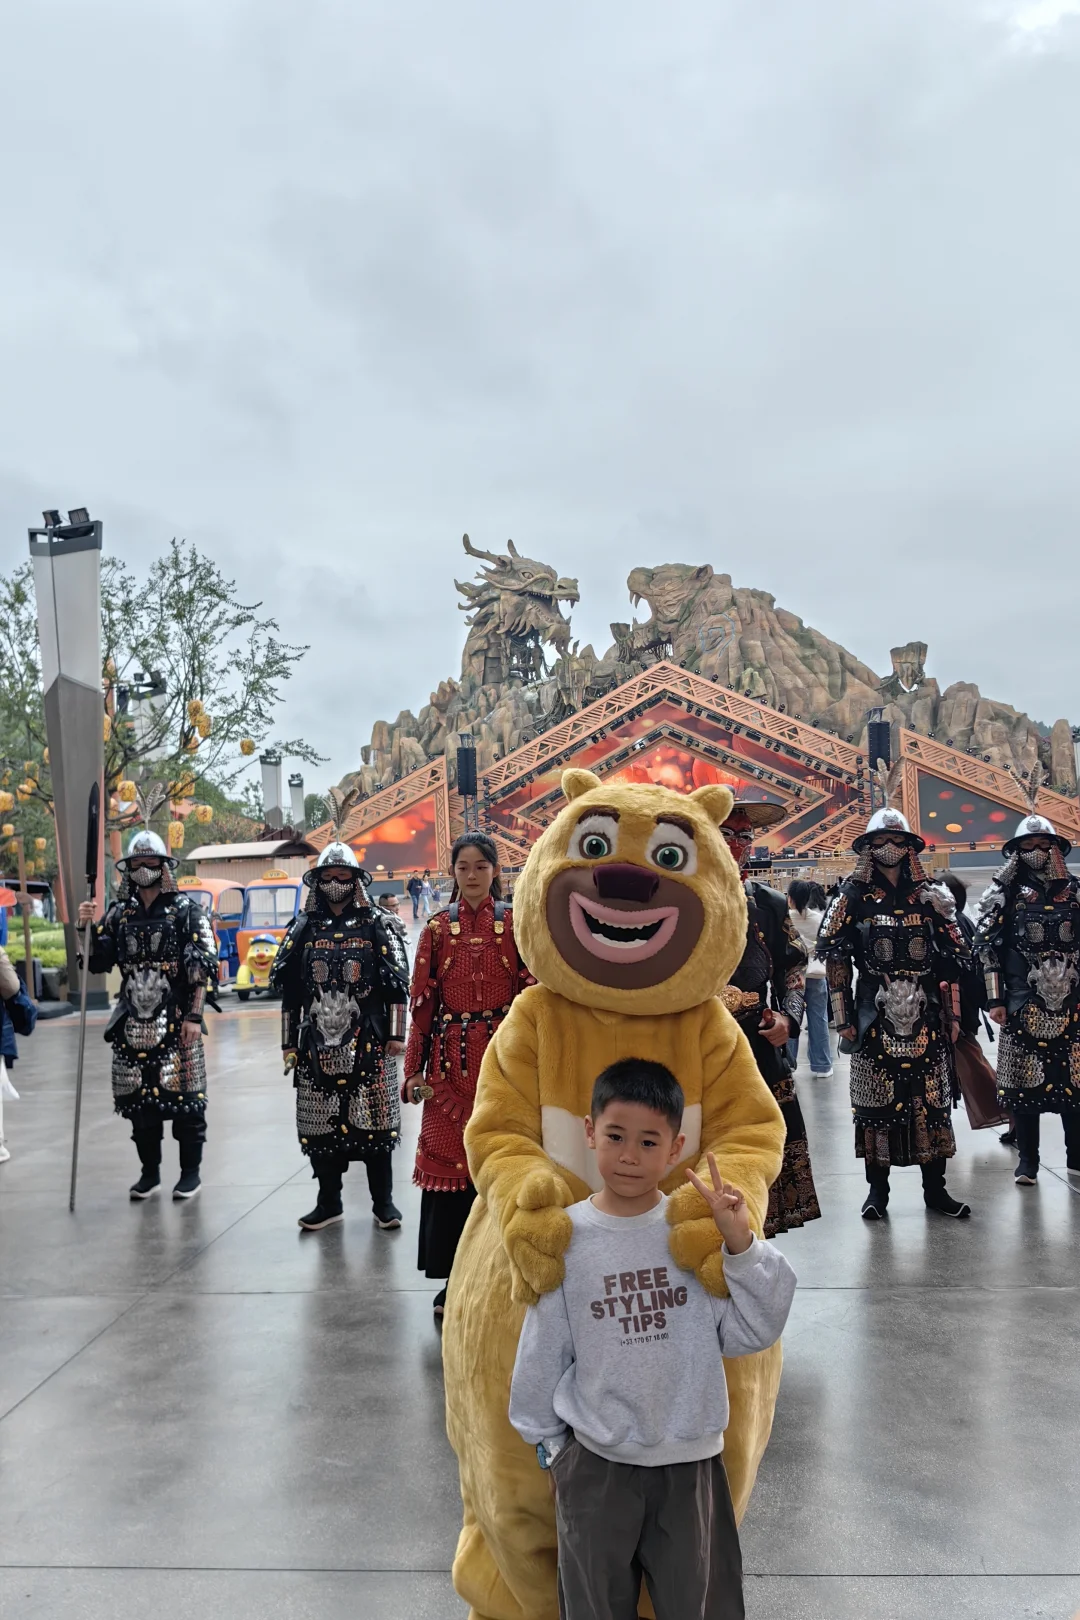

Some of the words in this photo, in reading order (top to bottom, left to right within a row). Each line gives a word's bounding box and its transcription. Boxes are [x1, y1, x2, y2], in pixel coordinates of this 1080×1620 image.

[603, 1267, 670, 1296] FREE
[590, 1286, 688, 1320] STYLING
[618, 1311, 667, 1334] TIPS
